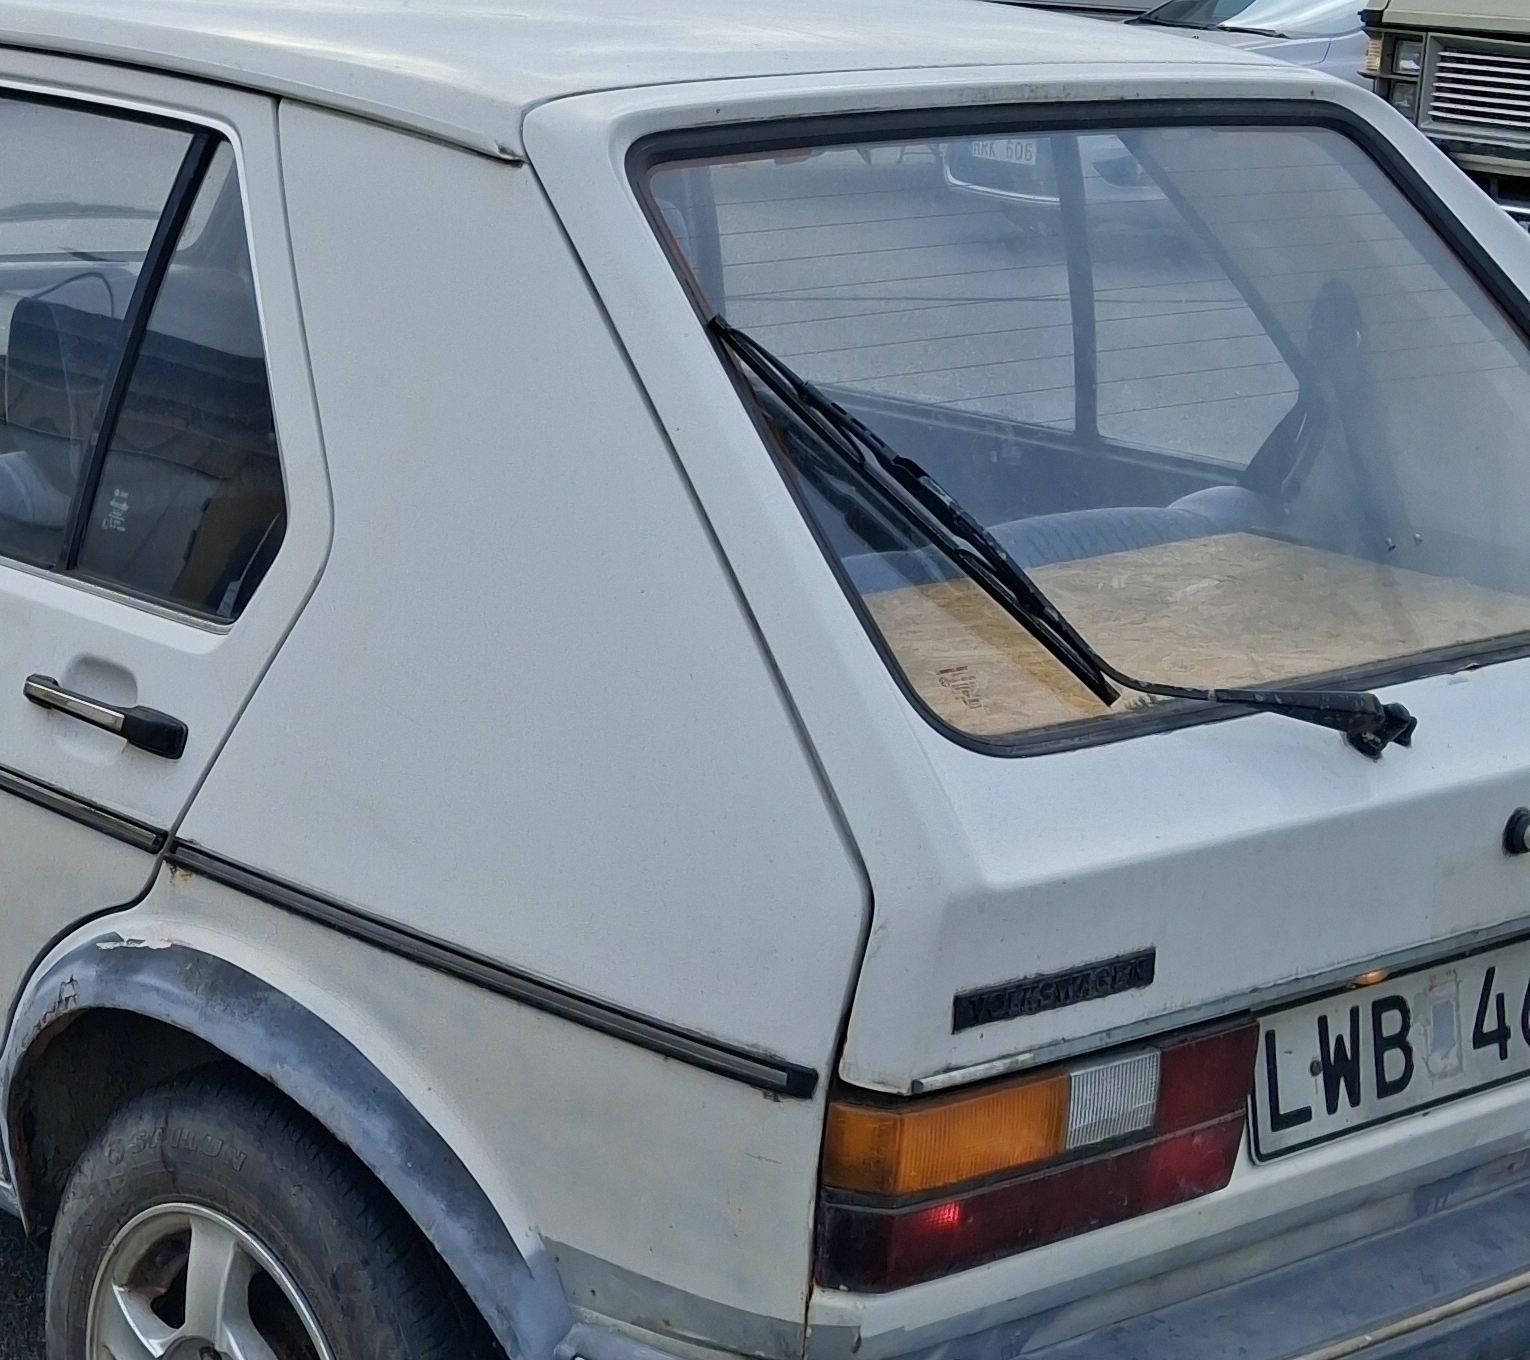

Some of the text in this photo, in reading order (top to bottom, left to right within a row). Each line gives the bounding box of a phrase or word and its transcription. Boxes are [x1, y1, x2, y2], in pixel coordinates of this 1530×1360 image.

[970, 957, 1148, 1024] VOLKSWAGEN
[1265, 966, 1530, 1133] LWB 4
